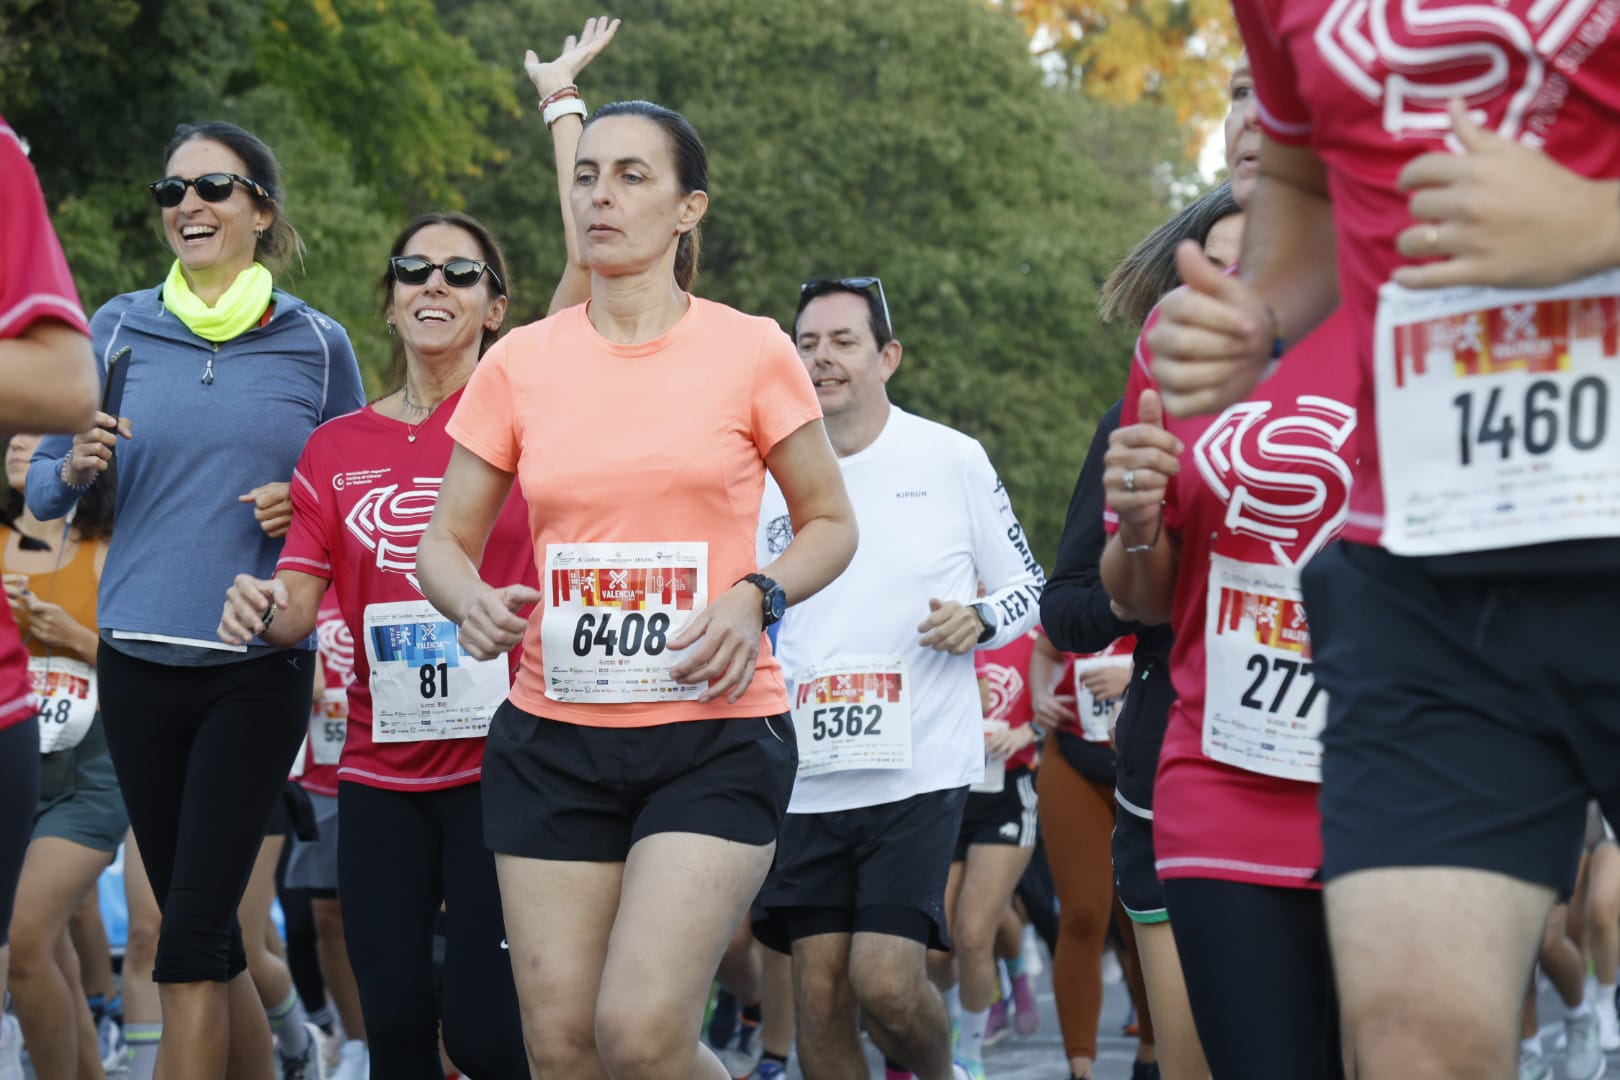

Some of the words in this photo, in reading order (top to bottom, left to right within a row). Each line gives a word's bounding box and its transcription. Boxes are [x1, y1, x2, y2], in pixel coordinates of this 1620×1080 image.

[1453, 375, 1609, 467] 1460
[896, 490, 927, 499] KIPRUN
[602, 590, 636, 599] VALENCIA
[573, 612, 671, 657] 6408
[420, 663, 448, 699] 81
[813, 704, 882, 741] 5362
